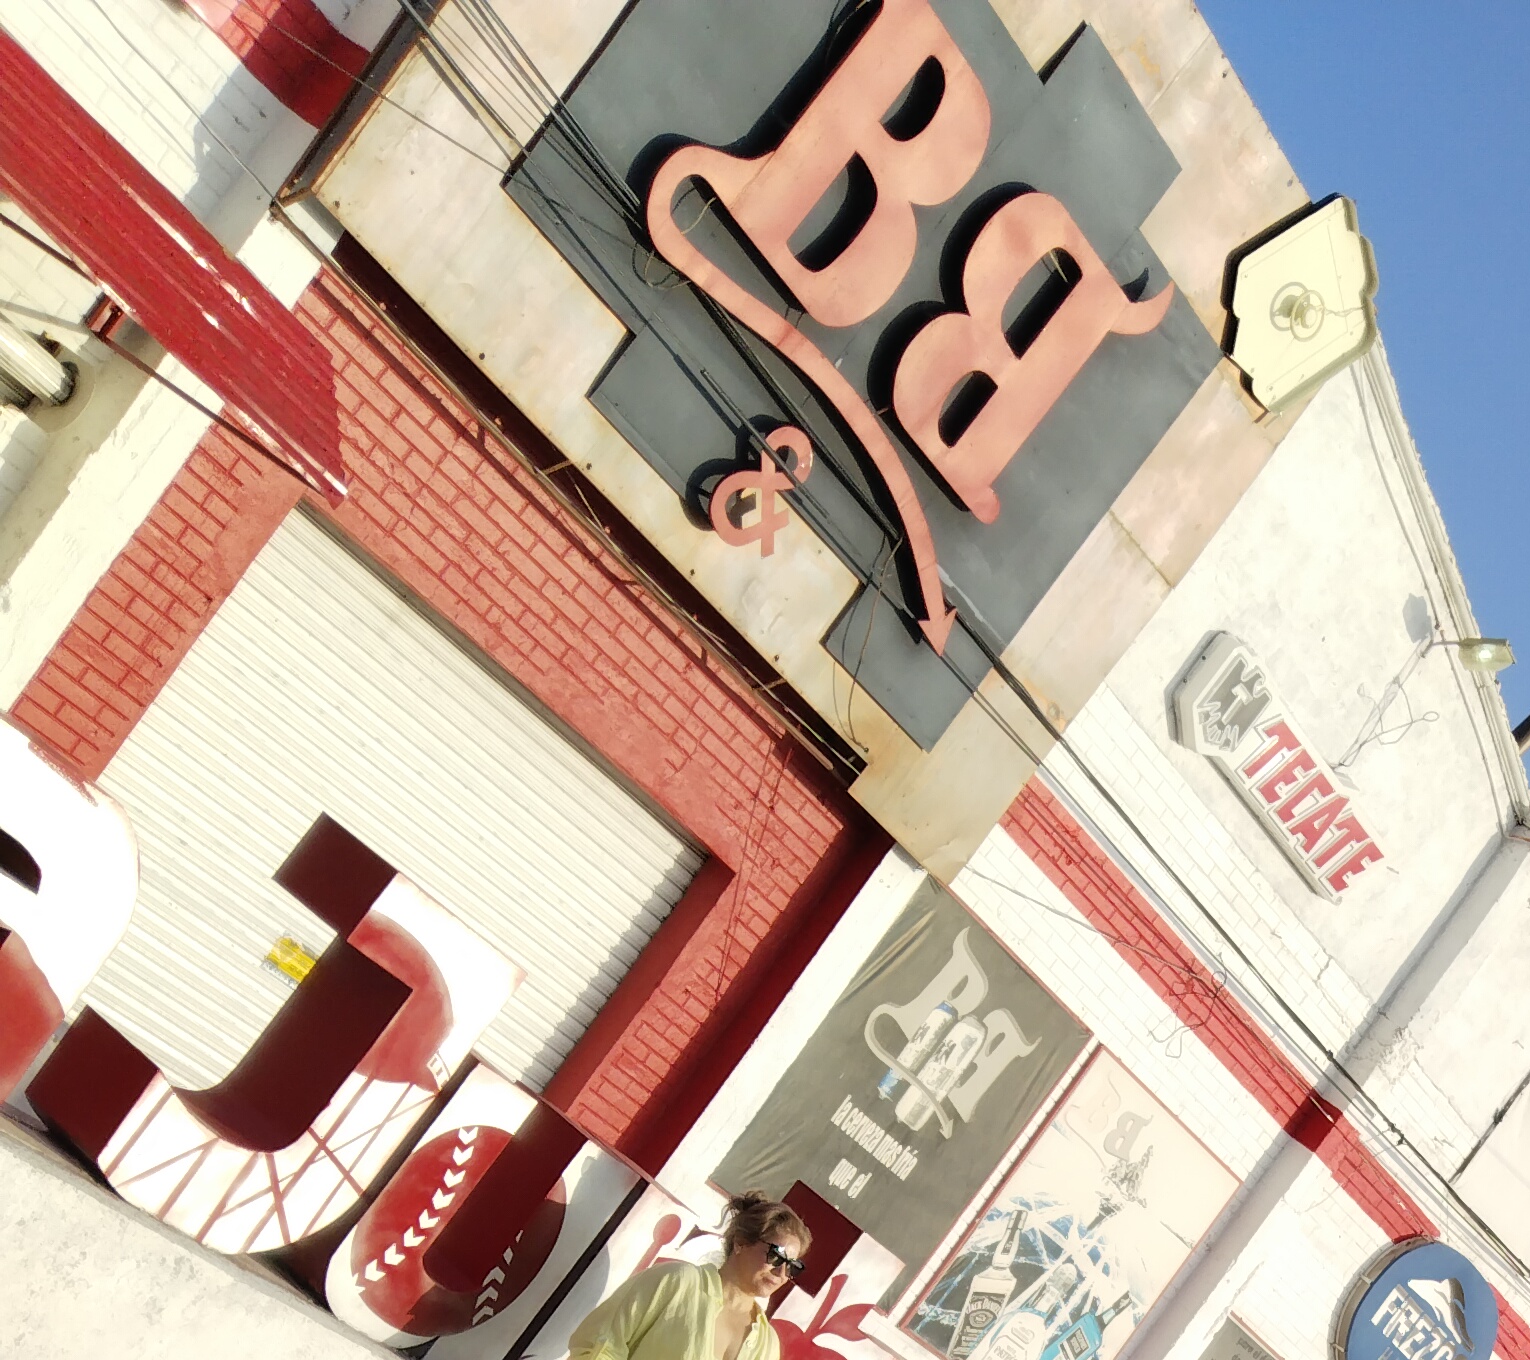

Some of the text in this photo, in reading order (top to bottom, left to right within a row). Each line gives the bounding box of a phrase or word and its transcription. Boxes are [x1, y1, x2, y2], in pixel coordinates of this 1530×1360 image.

[1242, 718, 1385, 893] TECATE
[830, 1093, 853, 1127] la
[840, 1106, 886, 1154] cerveza
[828, 1157, 873, 1199] que el
